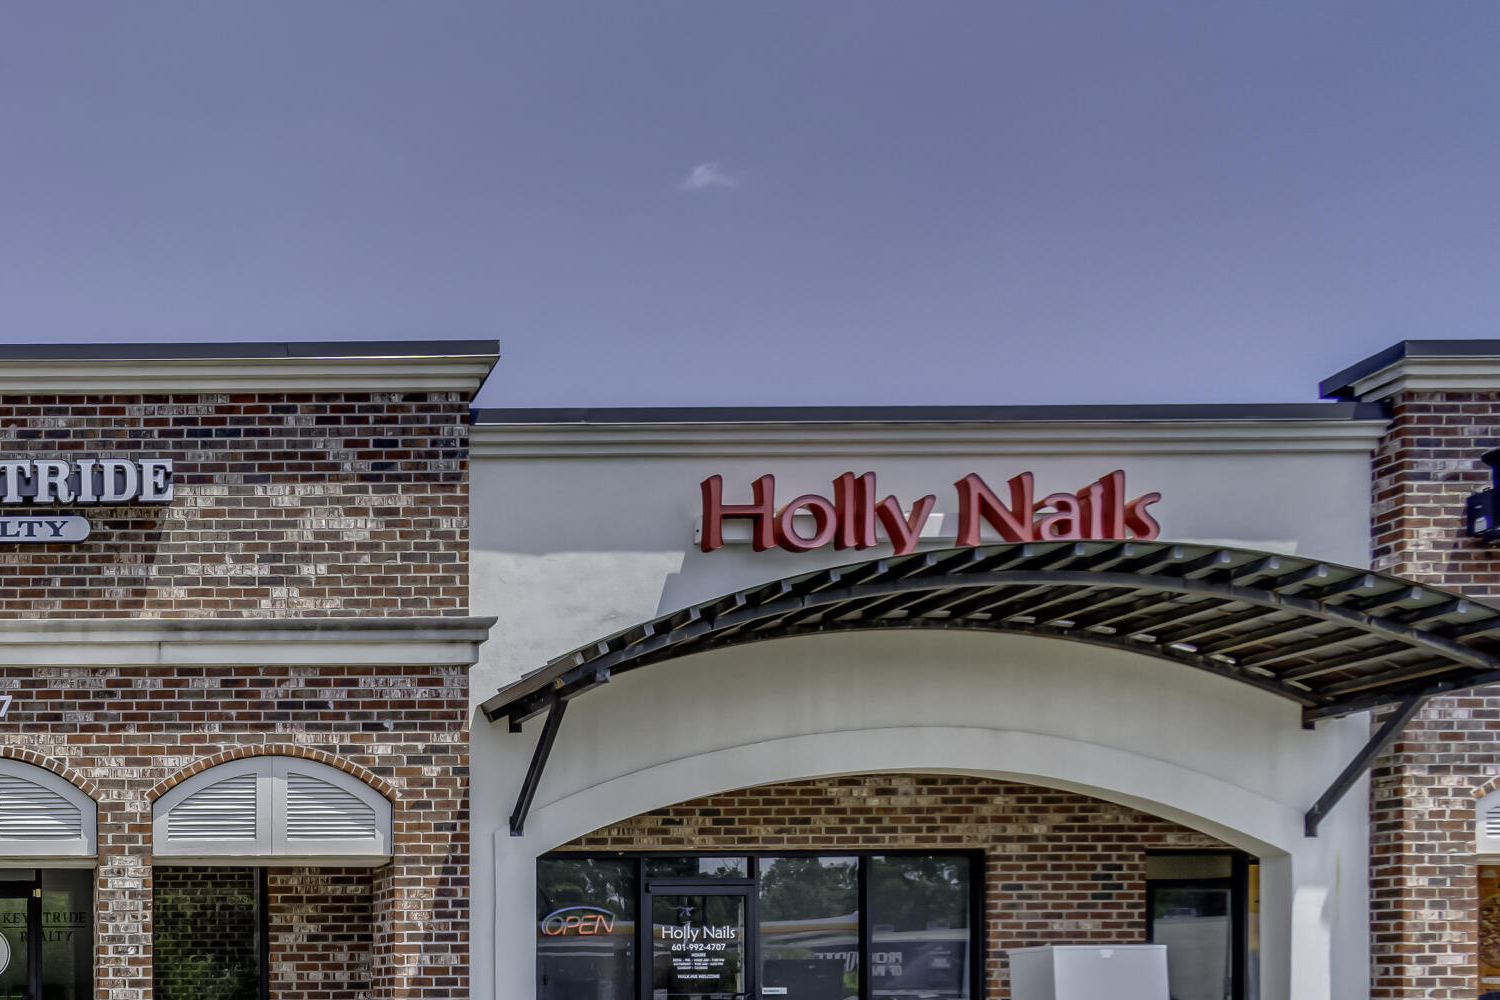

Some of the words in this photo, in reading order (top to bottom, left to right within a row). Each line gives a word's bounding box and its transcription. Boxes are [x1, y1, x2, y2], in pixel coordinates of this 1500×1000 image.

[701, 471, 936, 555] Holly
[954, 469, 1162, 547] Nails
[43, 911, 87, 924] TRIDE
[545, 914, 615, 935] OPEN
[19, 930, 73, 943] RALTY
[661, 925, 700, 942] Holly
[703, 925, 736, 939] Nails
[671, 943, 726, 951] 601-992-4707
